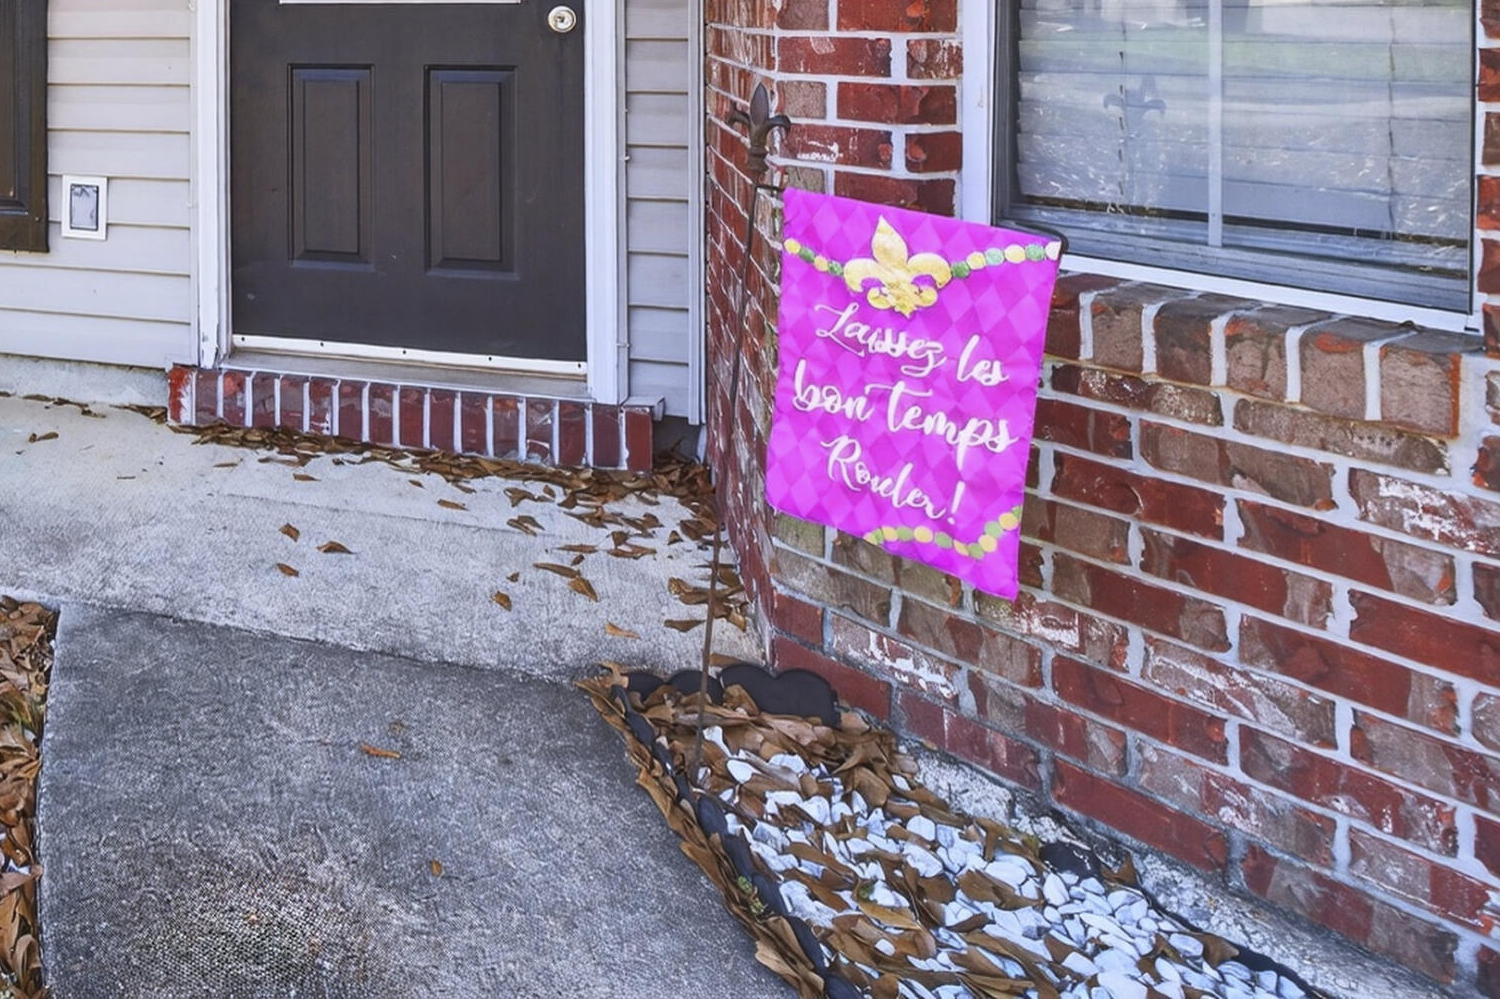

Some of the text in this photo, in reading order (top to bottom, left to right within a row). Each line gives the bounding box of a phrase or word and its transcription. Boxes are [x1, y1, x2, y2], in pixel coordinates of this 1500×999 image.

[792, 359, 875, 421] bon
[957, 334, 1010, 386] les
[820, 435, 966, 524] Rouler!
